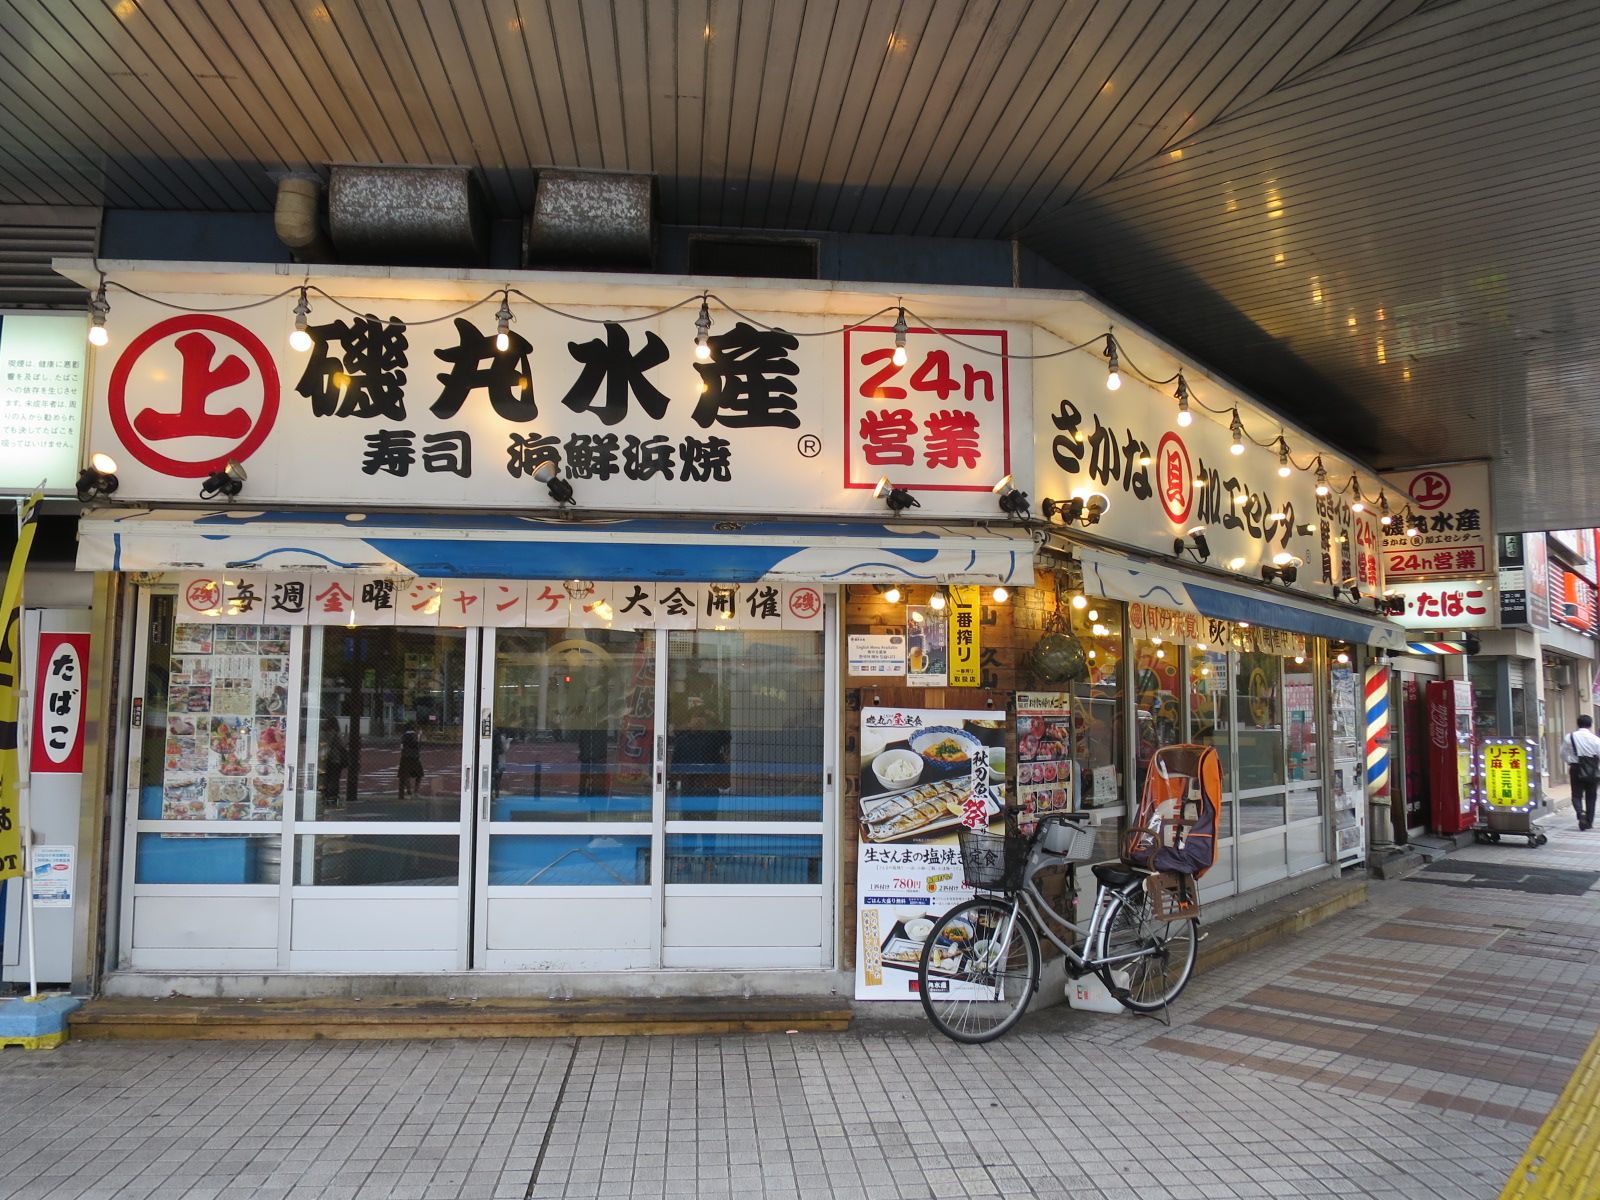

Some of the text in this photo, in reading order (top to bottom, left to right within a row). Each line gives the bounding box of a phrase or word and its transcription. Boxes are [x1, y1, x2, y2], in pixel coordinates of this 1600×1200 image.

[295, 314, 801, 429] 磯丸水産
[361, 429, 732, 483] 寿司 海鮮浜焼
[859, 408, 981, 469] 営業
[228, 579, 781, 619] 毎週金曜ジャンケン大会開催
[1383, 591, 1486, 617] ・たばこ
[957, 604, 972, 662] 一番搾り
[49, 654, 79, 751] たばこ
[1490, 747, 1520, 758] リーチ
[1490, 759, 1520, 769] 麻雀
[864, 847, 999, 865] 生さんまの塩焼き定食
[892, 878, 921, 889] 780円
